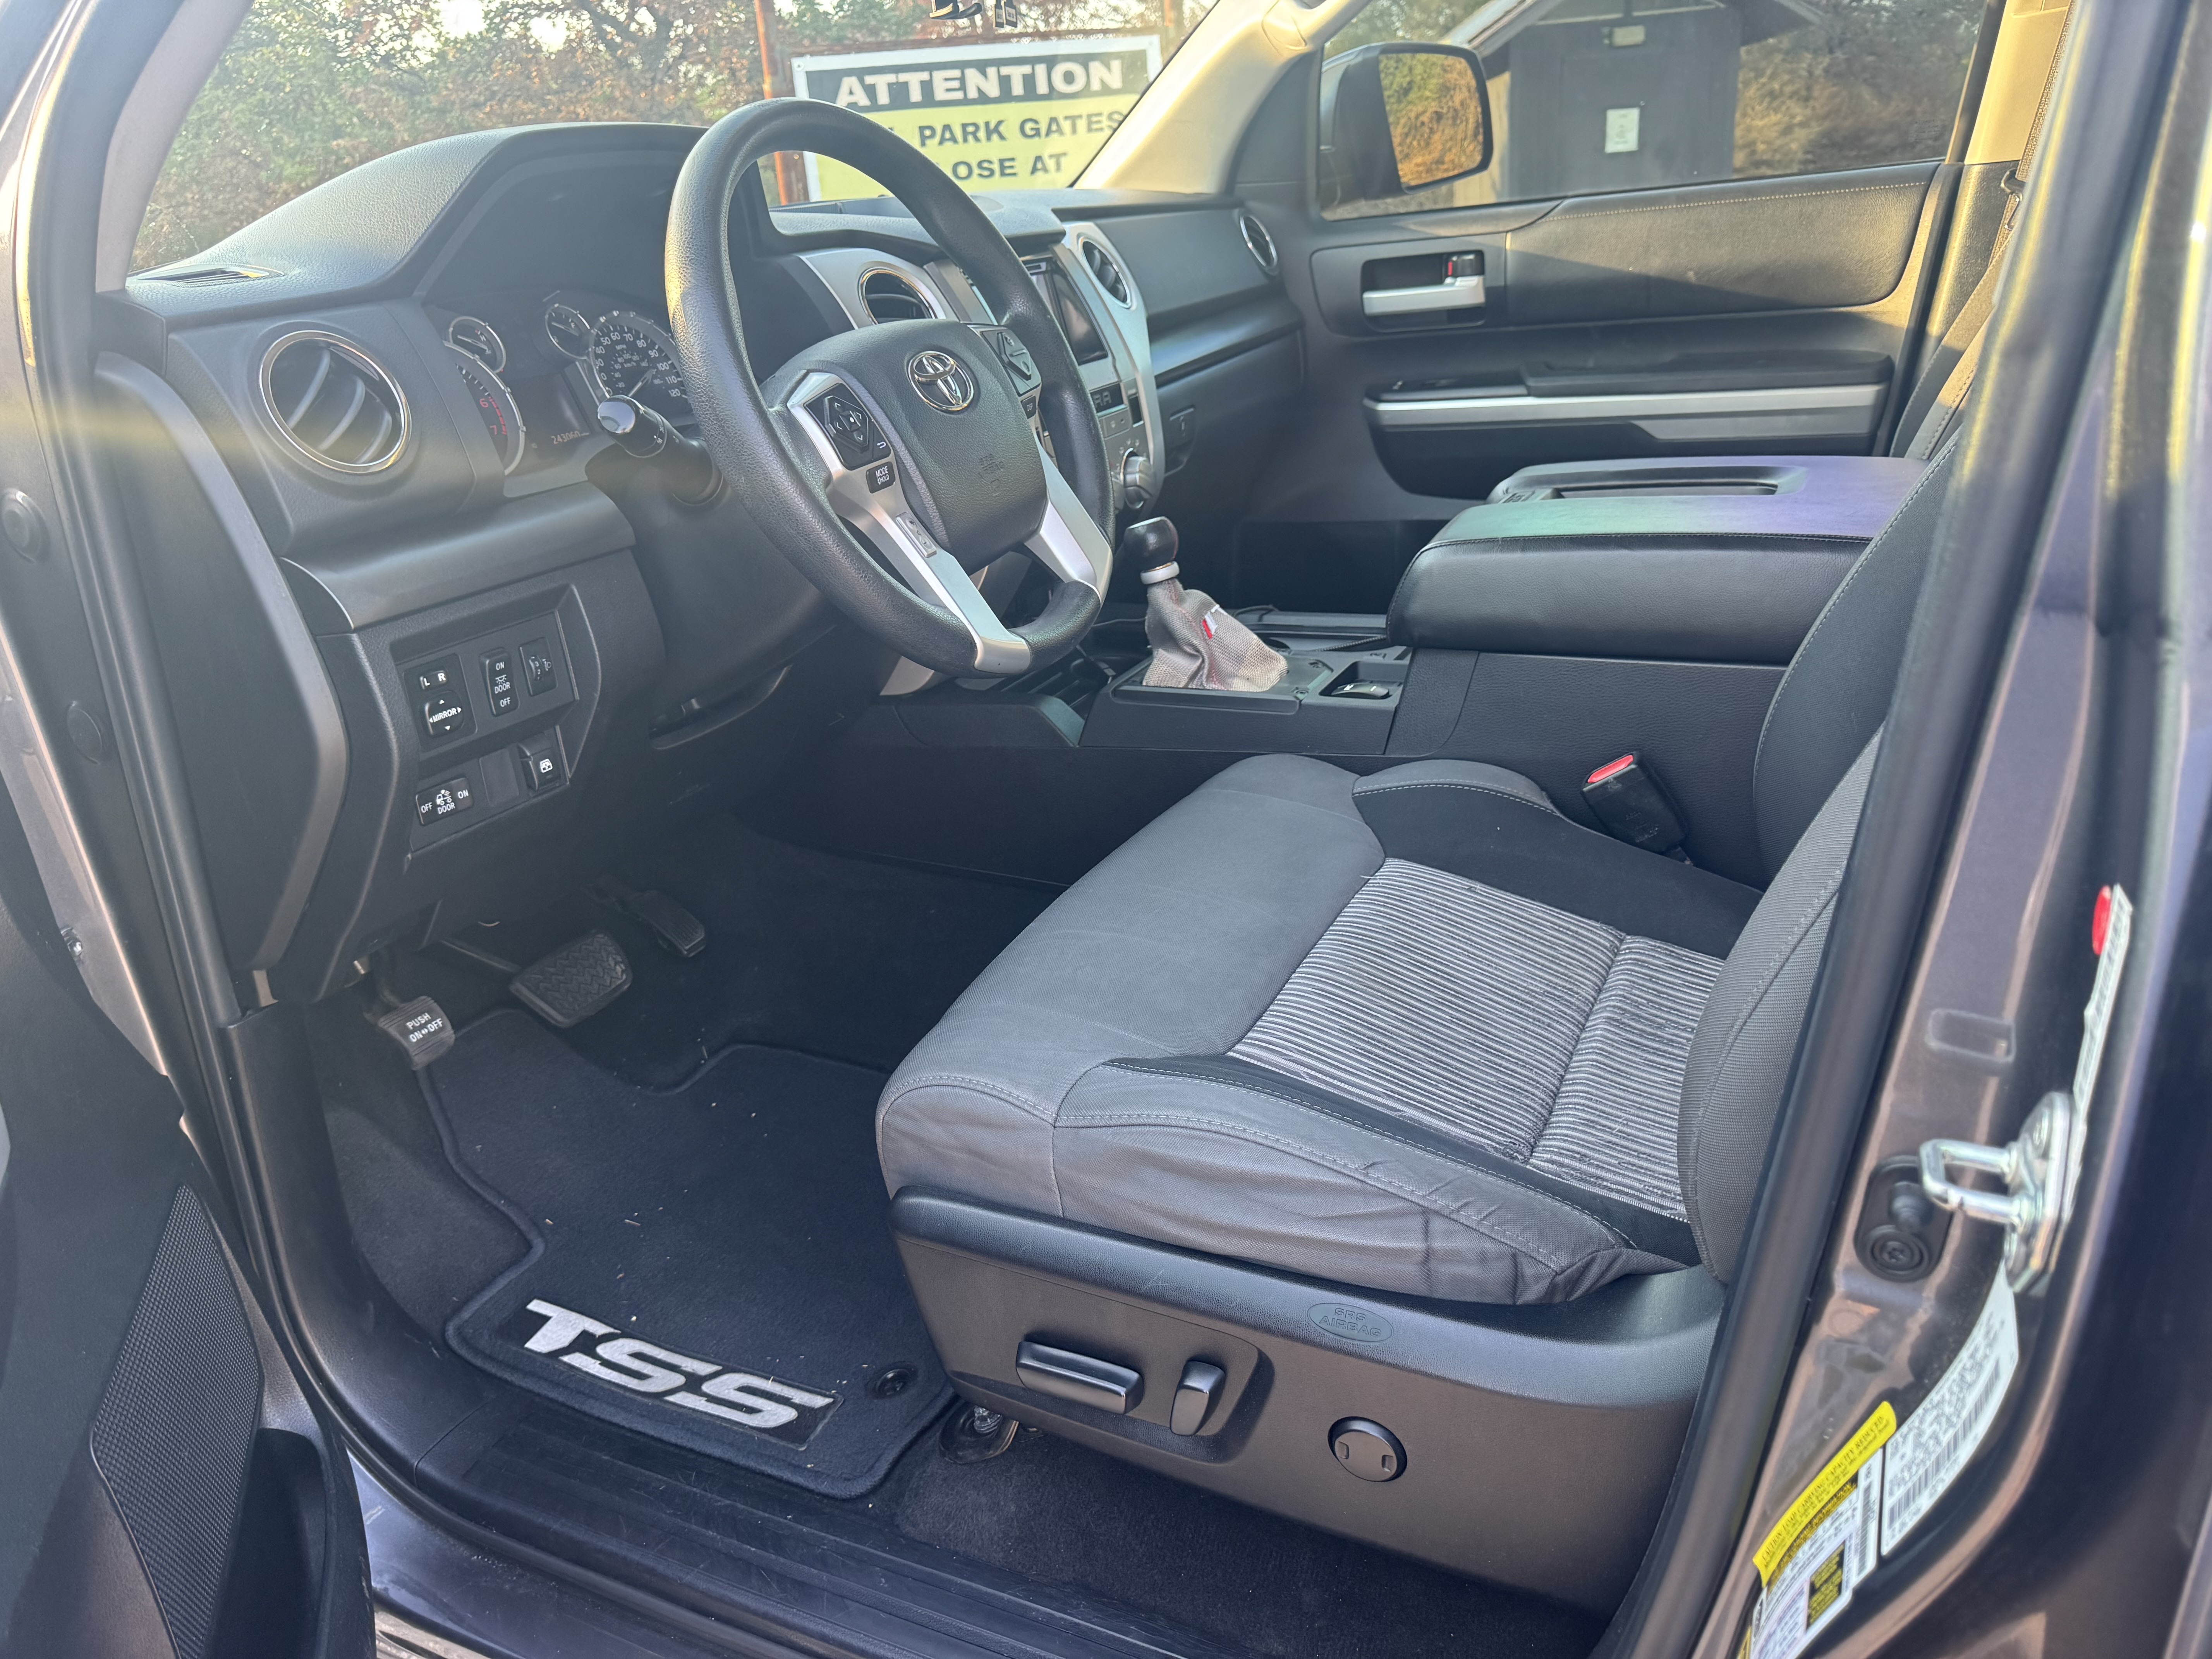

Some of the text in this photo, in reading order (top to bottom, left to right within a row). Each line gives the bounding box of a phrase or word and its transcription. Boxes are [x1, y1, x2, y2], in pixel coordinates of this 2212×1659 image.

[835, 59, 1123, 107] ATTENTION
[918, 110, 1125, 147] PARK GATES
[952, 152, 1067, 180] OSE AT
[601, 337, 611, 345] 50
[636, 339, 646, 348] 80
[648, 349, 659, 357] 90
[657, 362, 670, 371] 100
[665, 376, 677, 384] 110
[668, 388, 681, 397] 120
[479, 398, 489, 408] 6
[489, 425, 498, 435] 7
[876, 465, 889, 478] MODE
[496, 661, 505, 670] ON
[424, 673, 446, 686] L R
[494, 682, 511, 694] DOOR
[500, 697, 510, 707] OFF
[432, 708, 457, 722] MIRROR
[458, 789, 469, 799] ON
[421, 802, 433, 813] OFF
[437, 802, 455, 814] DOOR
[405, 1012, 431, 1030] PUSH
[409, 1018, 443, 1042] ON OFF
[1334, 1307, 1366, 1321] SRS
[1319, 1316, 1381, 1337] AIRBAG
[524, 1297, 834, 1429] TSS
